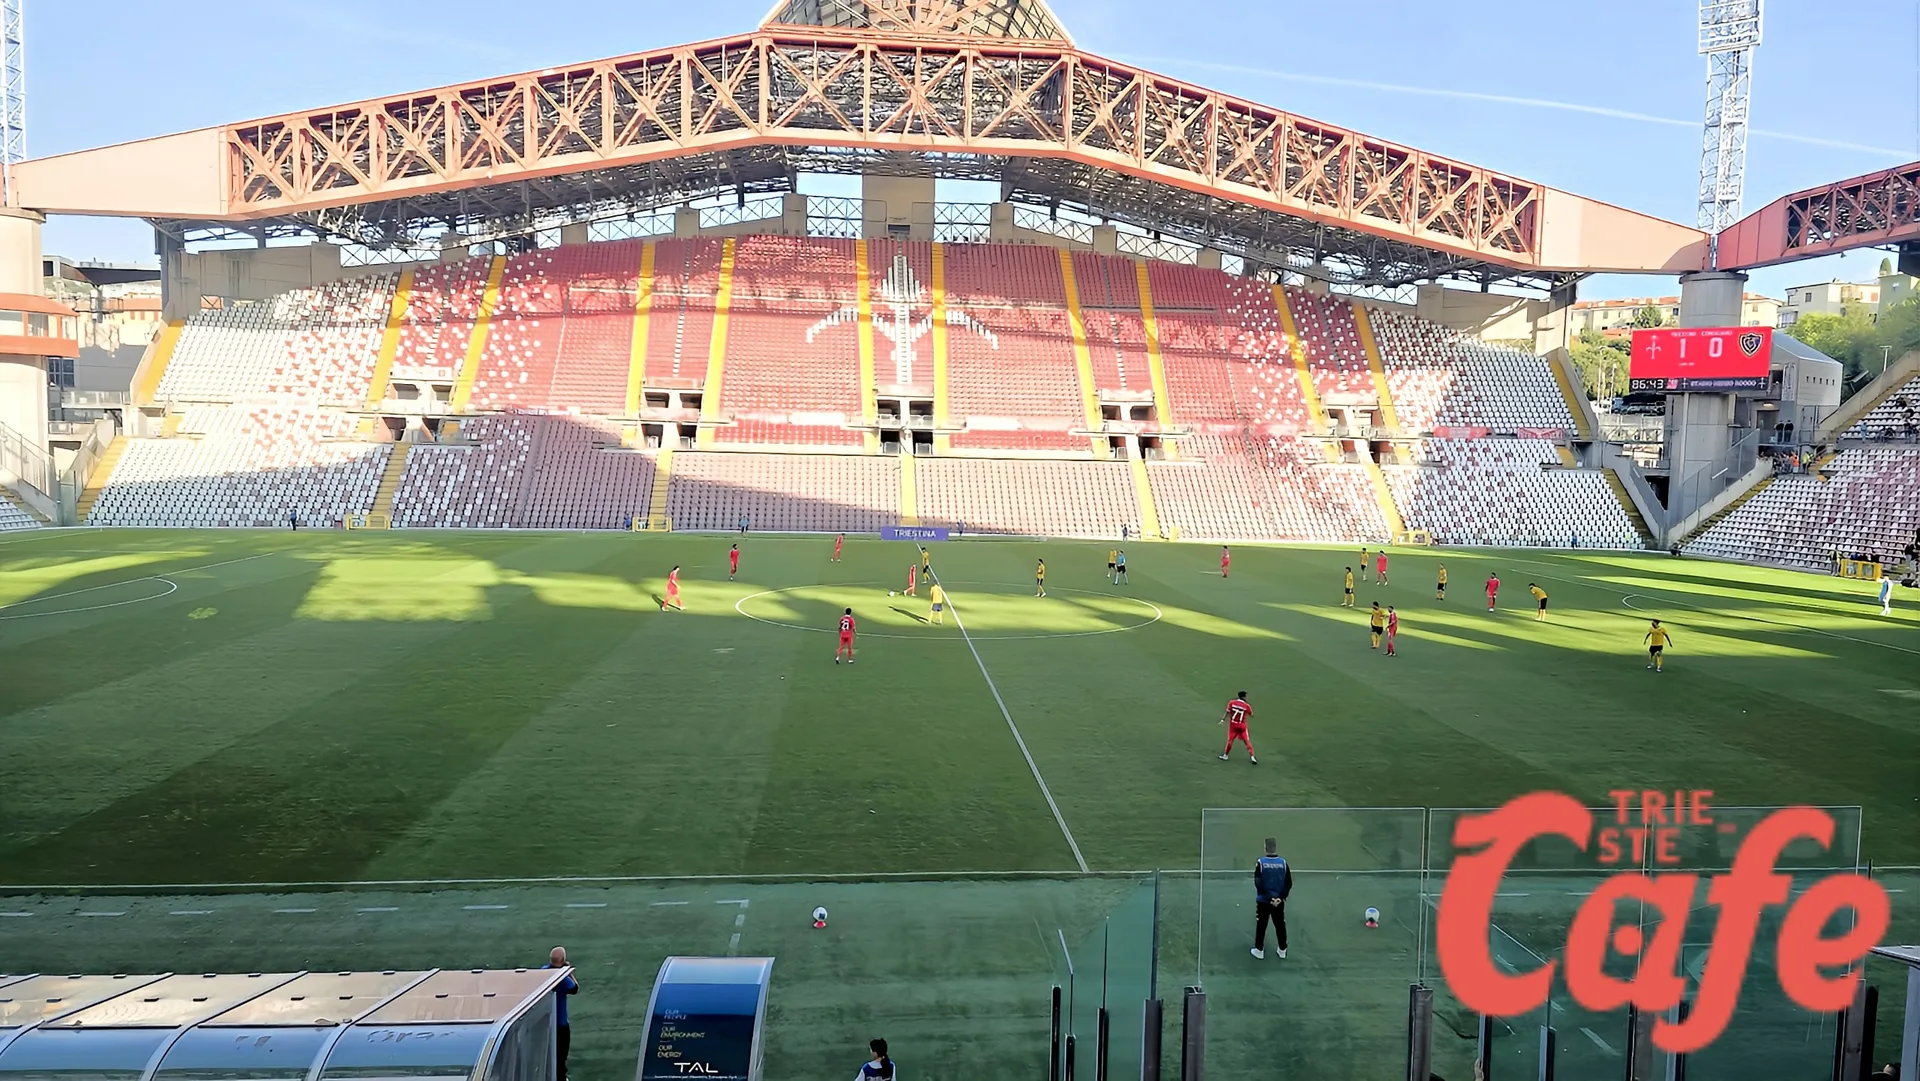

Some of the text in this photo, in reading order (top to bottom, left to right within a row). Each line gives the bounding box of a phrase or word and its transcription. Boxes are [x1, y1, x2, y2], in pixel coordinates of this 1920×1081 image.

[1680, 337, 1722, 358] 1 0
[1631, 380, 1664, 389] 86:43
[894, 529, 936, 537] TRIESTINA
[673, 1062, 719, 1073] TAL
